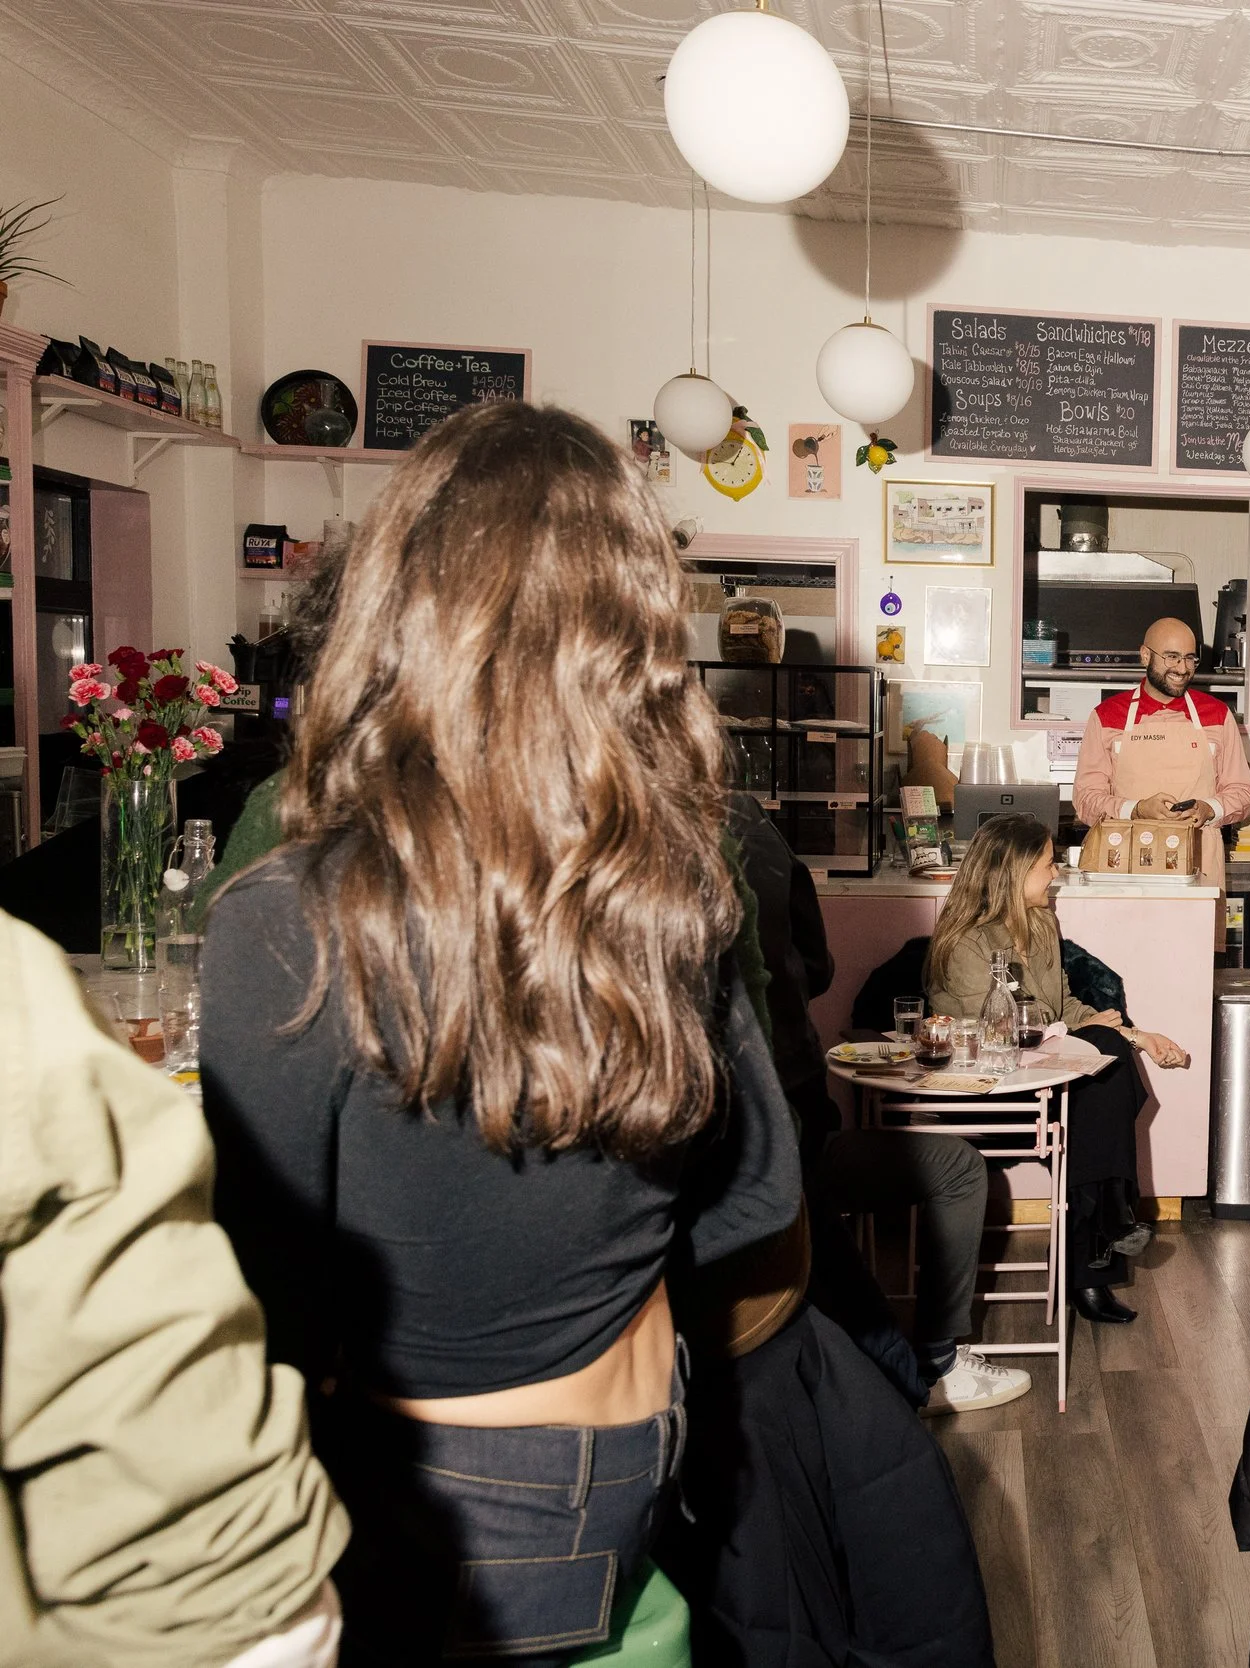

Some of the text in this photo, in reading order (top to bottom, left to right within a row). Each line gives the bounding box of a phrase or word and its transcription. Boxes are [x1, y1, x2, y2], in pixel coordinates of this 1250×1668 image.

[952, 318, 1006, 340] Salads
[1037, 322, 1126, 345] Sandwhiches
[1046, 347, 1076, 361] Bacon
[1078, 348, 1095, 364] Egg
[942, 359, 961, 370] Kale
[377, 373, 409, 387] Cold
[413, 373, 447, 387] Brew
[941, 374, 980, 385] Couscous
[378, 388, 410, 398] Iced
[414, 388, 457, 402] Coffee
[956, 389, 1032, 412] Soups $8/16
[376, 400, 448, 413] Drip Coffee
[1060, 401, 1135, 421] Bowls $20
[376, 413, 413, 427] Rosey
[376, 428, 402, 438] Hot
[940, 425, 980, 437] Roasted
[1046, 424, 1138, 438] Hot Shawarma Bowl
[1181, 433, 1197, 446] Join
[949, 439, 1027, 458] Available Everyday
[1186, 450, 1225, 465] Weekdays
[222, 697, 256, 706] Coffee
